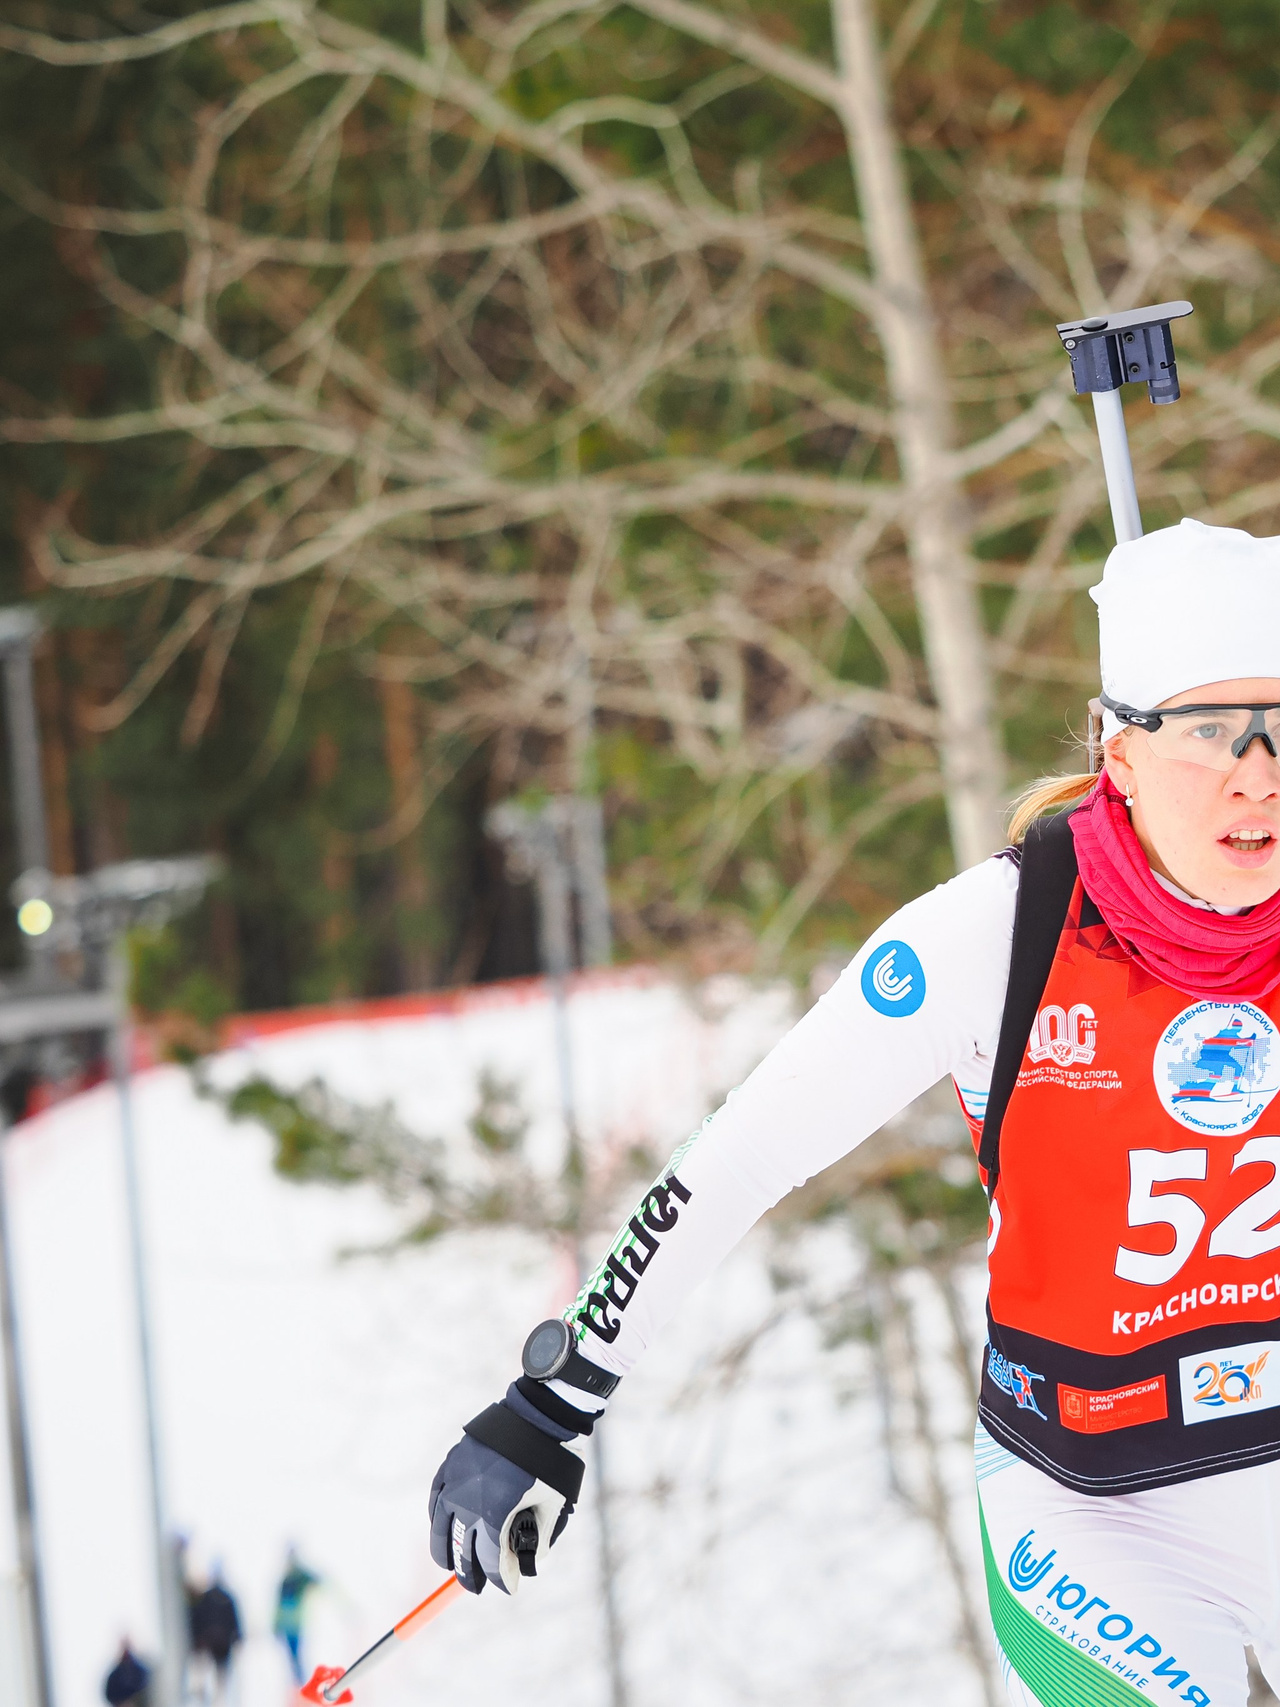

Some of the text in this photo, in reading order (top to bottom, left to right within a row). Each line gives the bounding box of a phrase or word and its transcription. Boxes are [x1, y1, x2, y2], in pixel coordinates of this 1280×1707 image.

[1080, 1020, 1099, 1029] ЛЕТ
[1233, 1003, 1274, 1036] РОССИИ
[1016, 1075, 1123, 1090] ОССИЙСКОЙ ФЕДЕРАЦИИ
[1083, 1070, 1119, 1079] СПОРТА
[1180, 1110, 1238, 1131] Красноярск
[1241, 1103, 1265, 1125] 2023
[1089, 1381, 1160, 1404] КРАСНОЯРСКИЙ
[1193, 1361, 1251, 1405] 20
[1089, 1402, 1114, 1412] КРАЙ
[1035, 1605, 1150, 1689] СТРАХОВАНИЕ
[1046, 1574, 1211, 1707] ЮГОРИЯ
